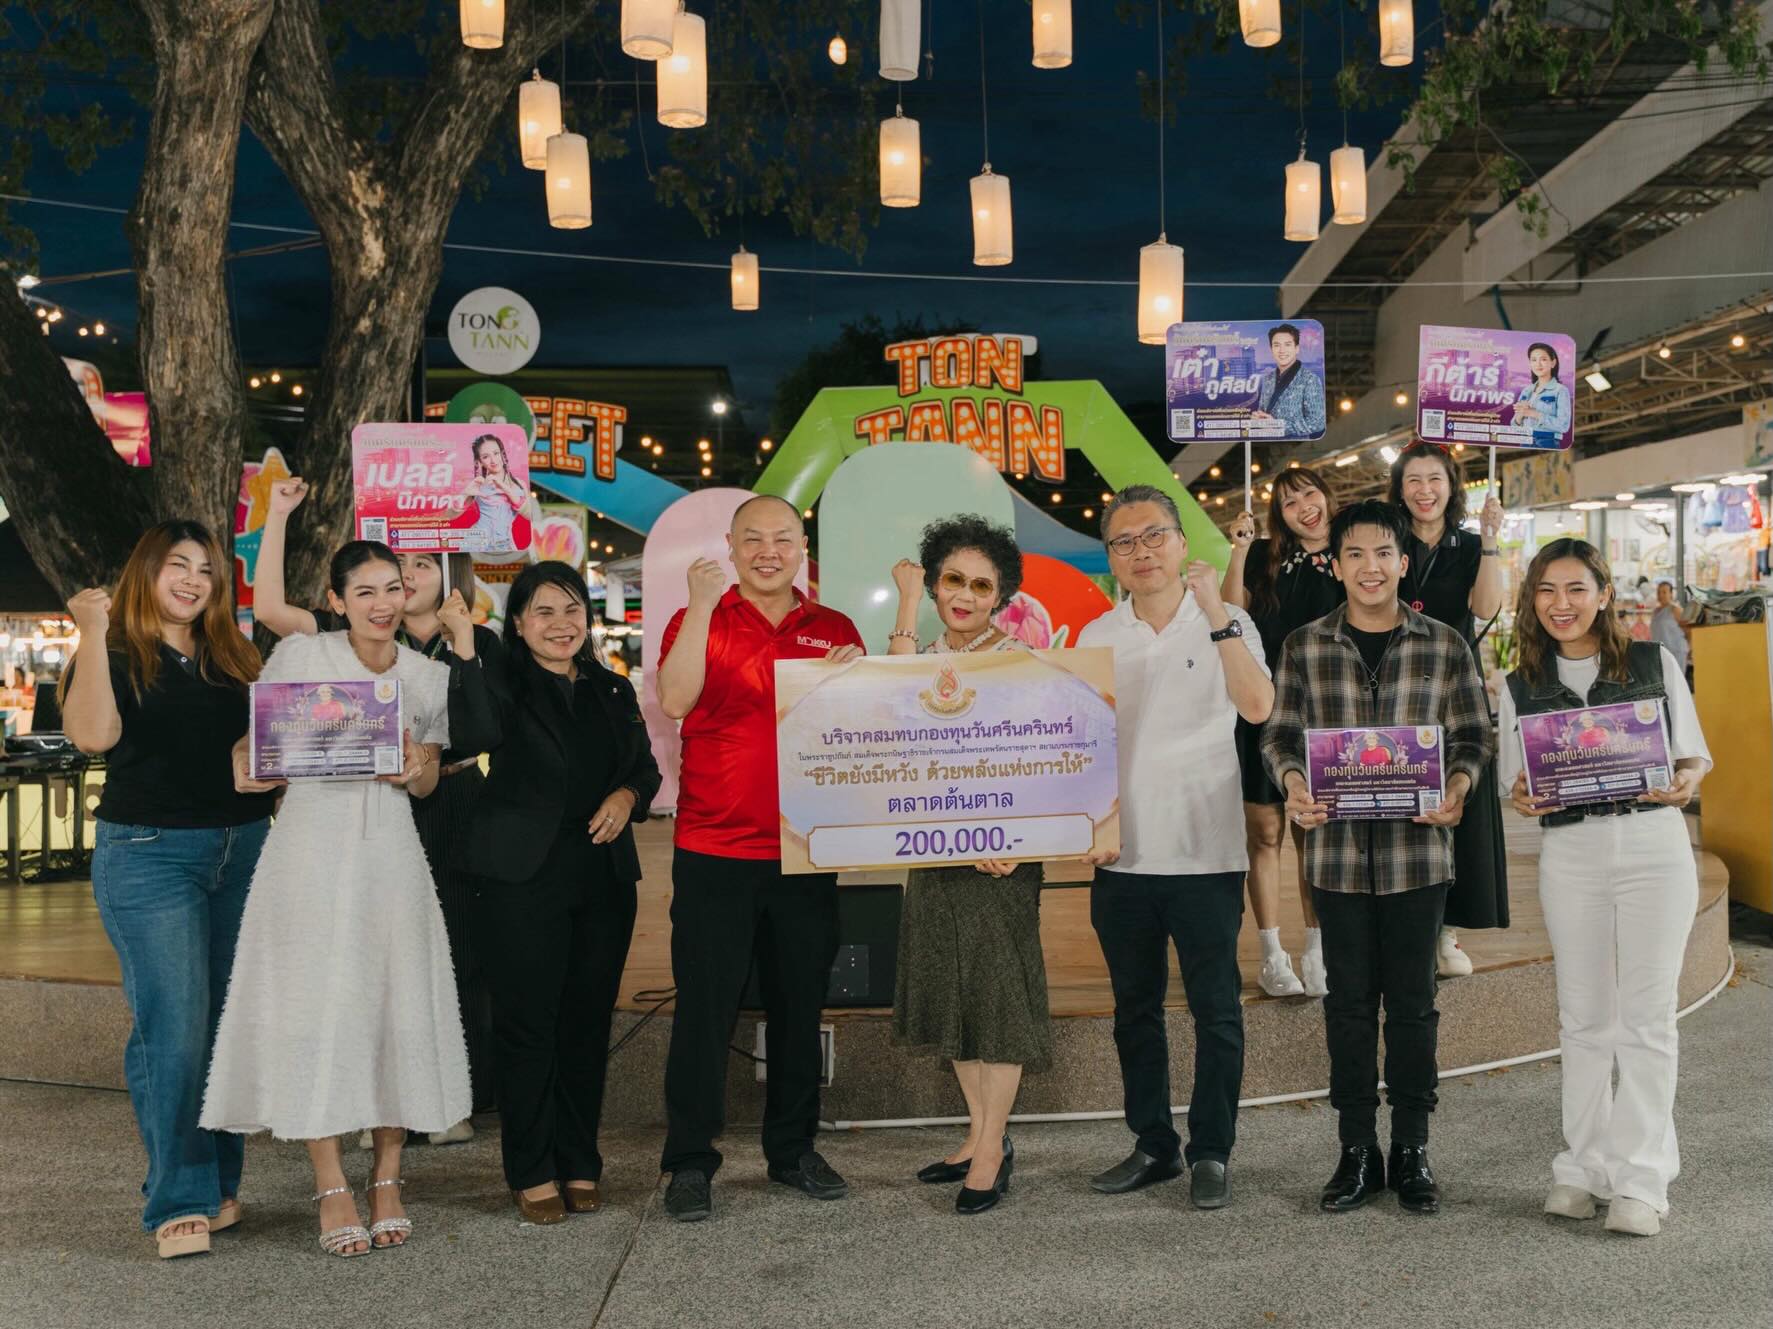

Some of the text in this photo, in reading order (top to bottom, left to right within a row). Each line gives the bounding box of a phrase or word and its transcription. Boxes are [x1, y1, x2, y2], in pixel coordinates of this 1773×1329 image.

[470, 331, 529, 351] TANN
[885, 336, 1023, 396] TON
[1173, 348, 1220, 378] เต๋า
[855, 397, 1067, 482] TANN
[366, 453, 457, 488] เบลล์
[821, 715, 1074, 747] บริจาคสมทบกองทุนวันศรีนครินทร์
[887, 787, 1014, 814] ตลาดต้นตาล
[895, 826, 1023, 857] 200,000.-
